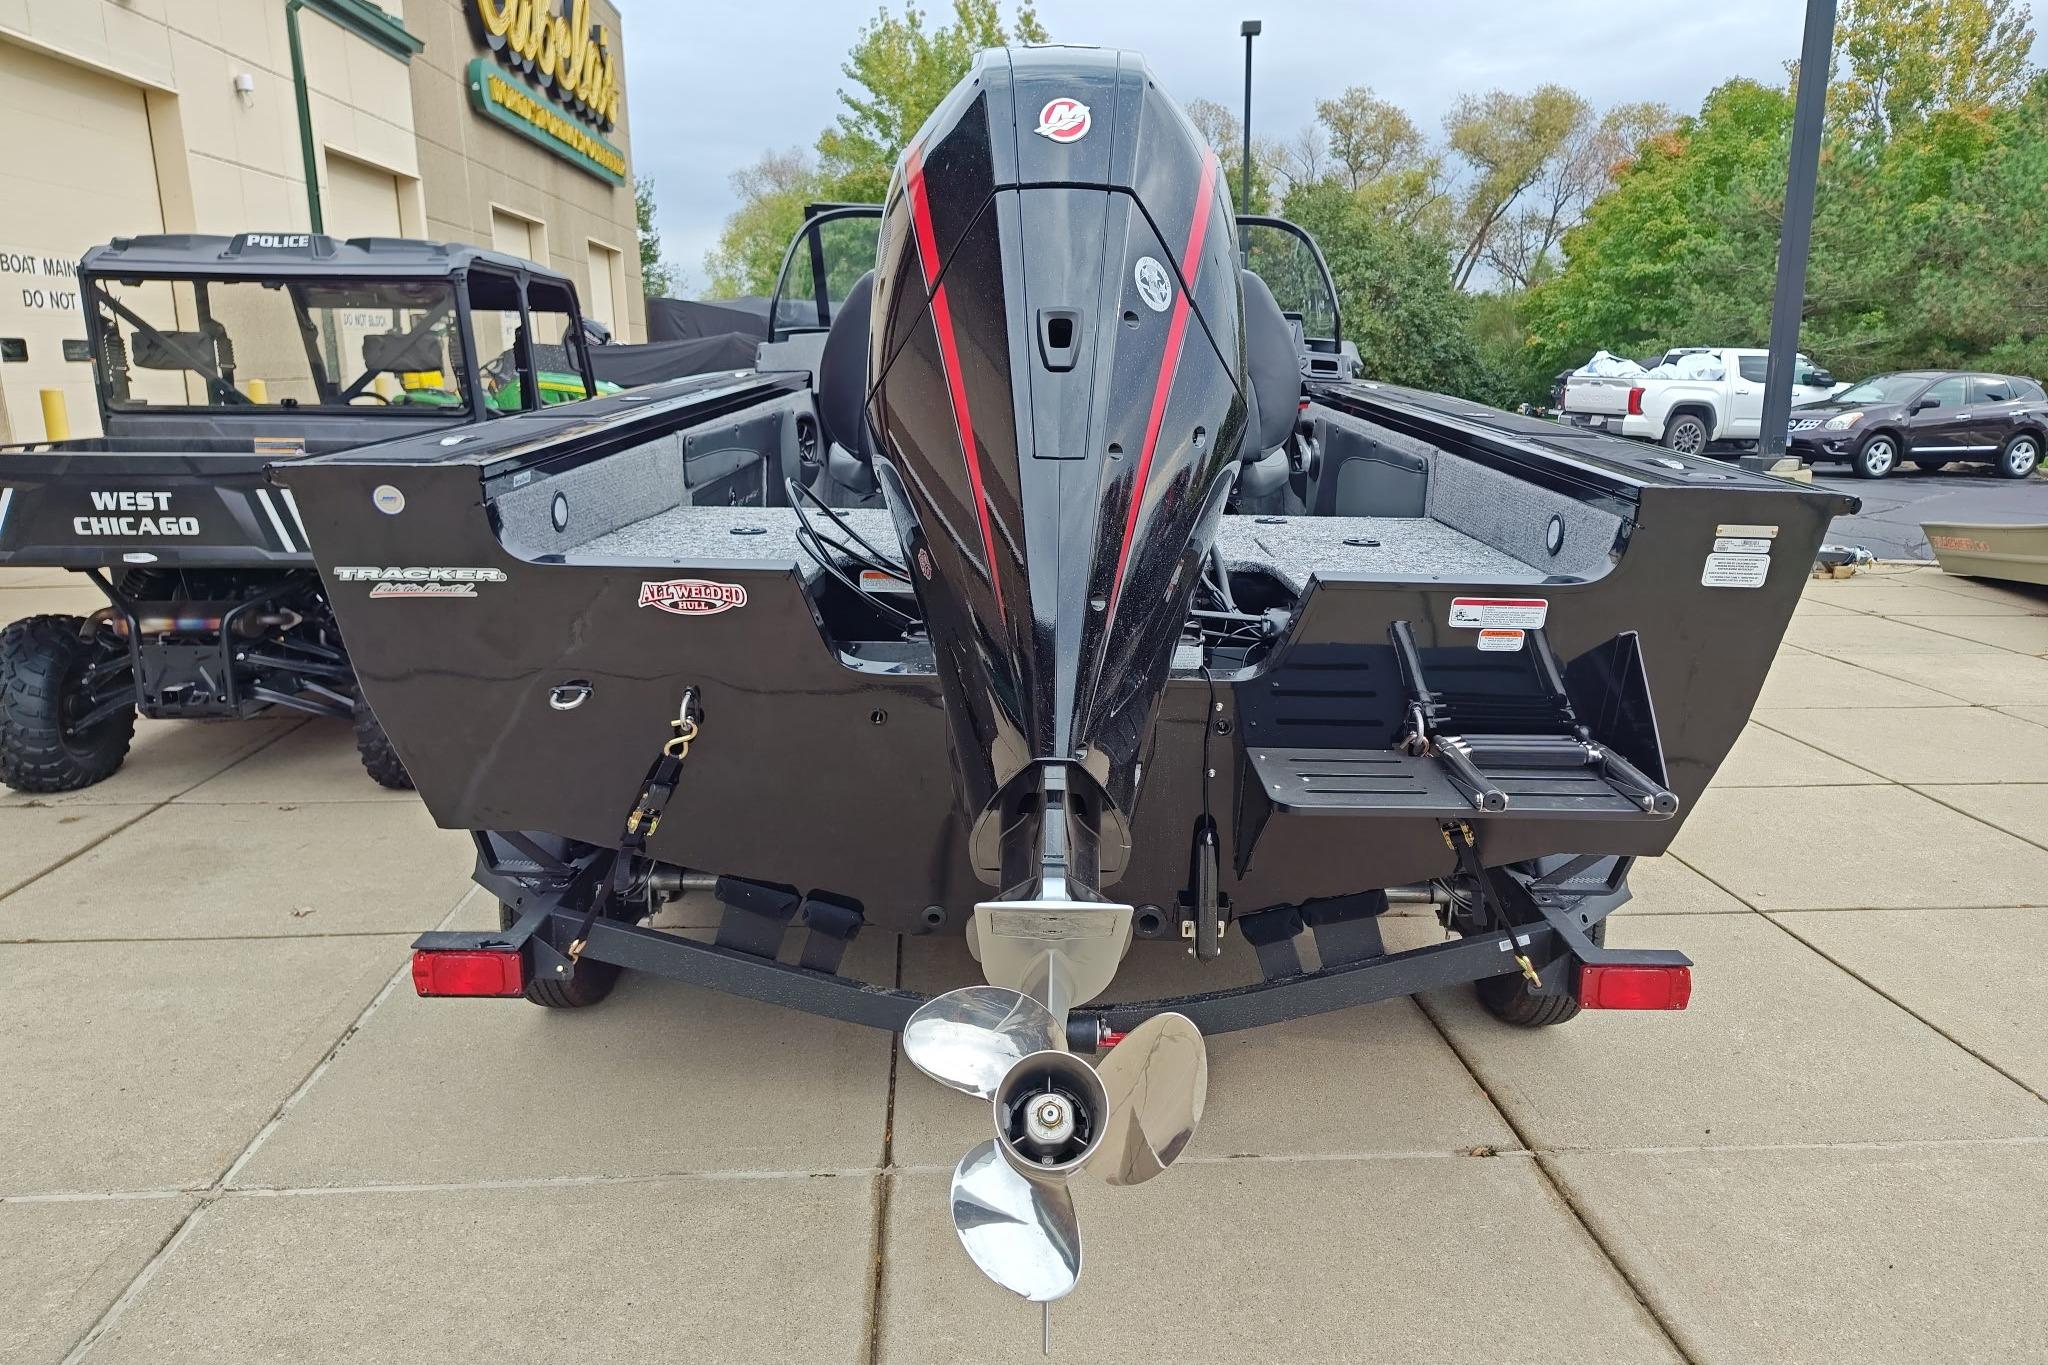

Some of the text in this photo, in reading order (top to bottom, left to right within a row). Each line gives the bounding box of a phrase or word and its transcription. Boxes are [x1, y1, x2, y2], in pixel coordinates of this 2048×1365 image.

[246, 234, 310, 248] POLICE
[0, 253, 36, 275] BOAT
[22, 289, 76, 310] DO NOT
[90, 491, 172, 511] WEST
[73, 516, 200, 536] CHICAGO
[334, 566, 501, 581] TRACKER
[641, 583, 744, 605] ALL WELDED
[678, 601, 709, 610] HULL
